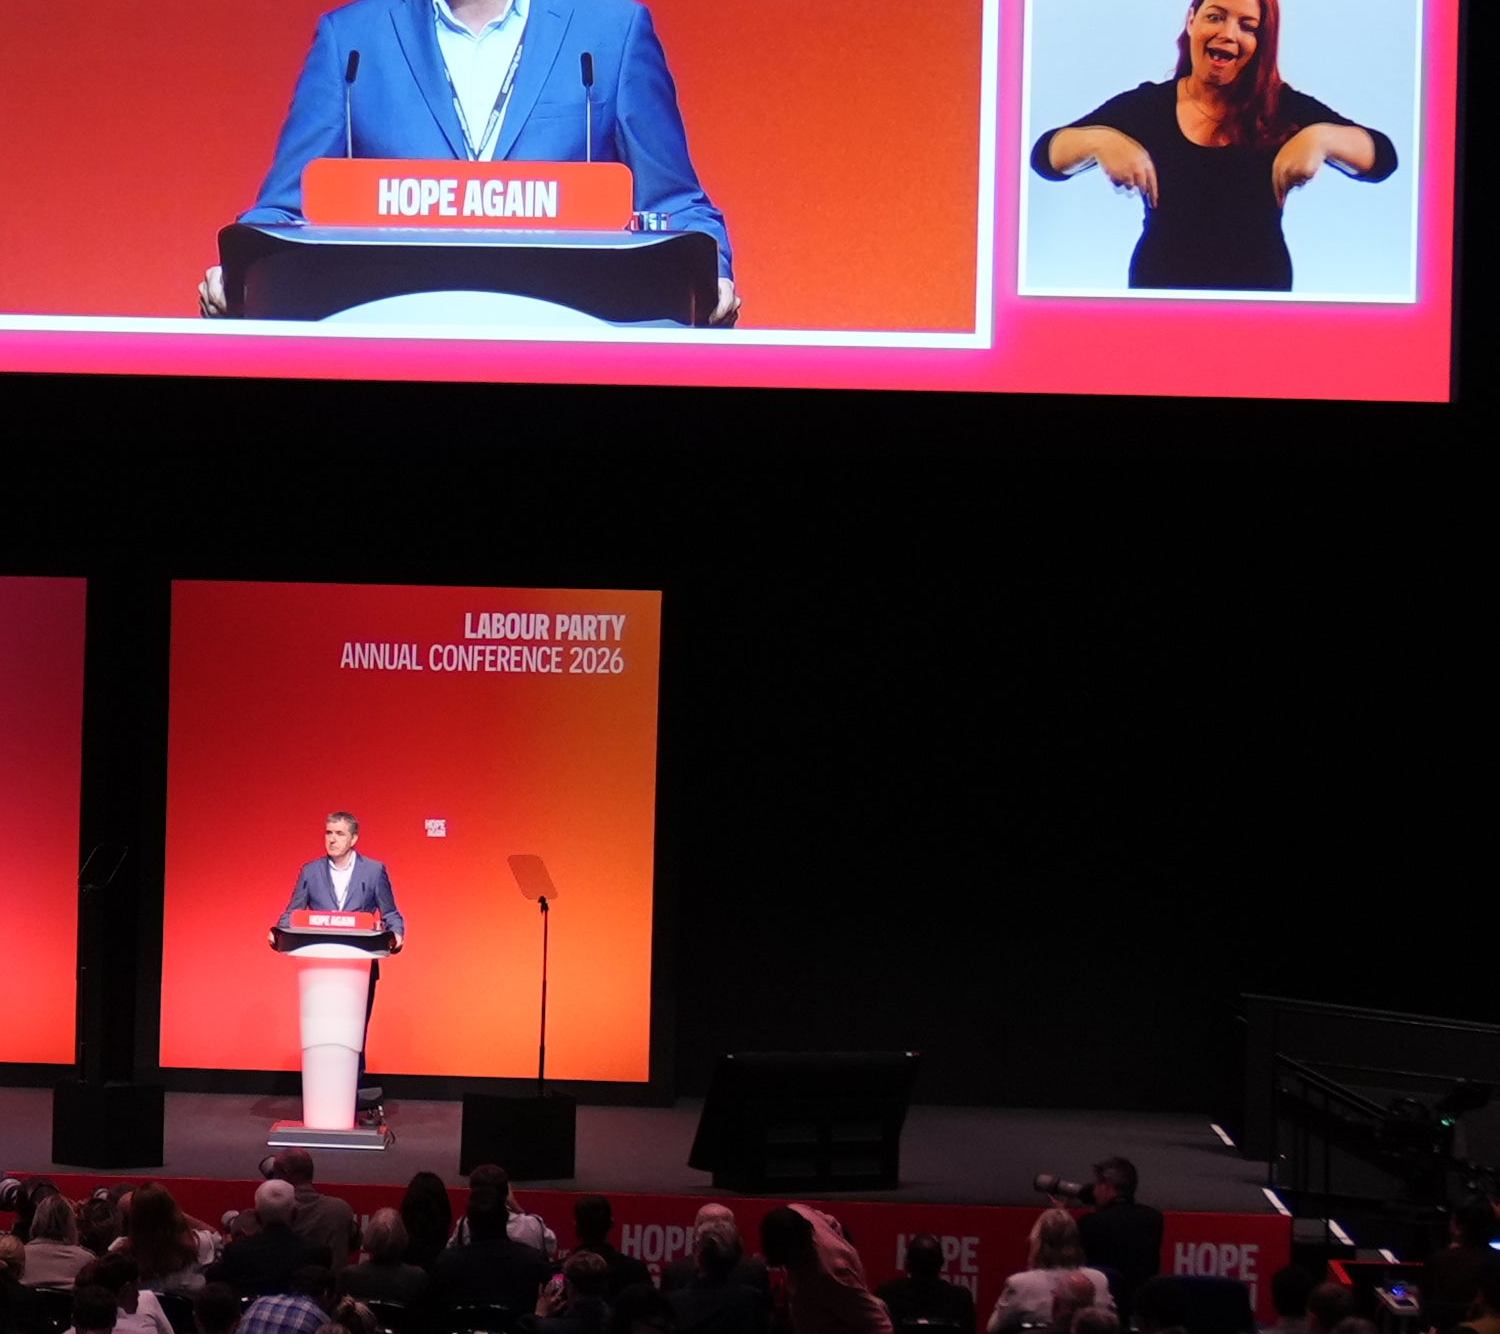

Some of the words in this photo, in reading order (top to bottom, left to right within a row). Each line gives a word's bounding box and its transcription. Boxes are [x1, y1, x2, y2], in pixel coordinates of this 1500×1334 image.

[378, 178, 458, 217] HOPE
[462, 180, 558, 218] AGAIN
[464, 612, 549, 641] LABOUR
[555, 614, 626, 642] PARTY
[340, 642, 423, 671] ANNUAL
[429, 644, 563, 674] CONFERENCE
[568, 646, 624, 675] 2026
[425, 819, 446, 830] HOPE
[1173, 1241, 1260, 1282] HOPE
